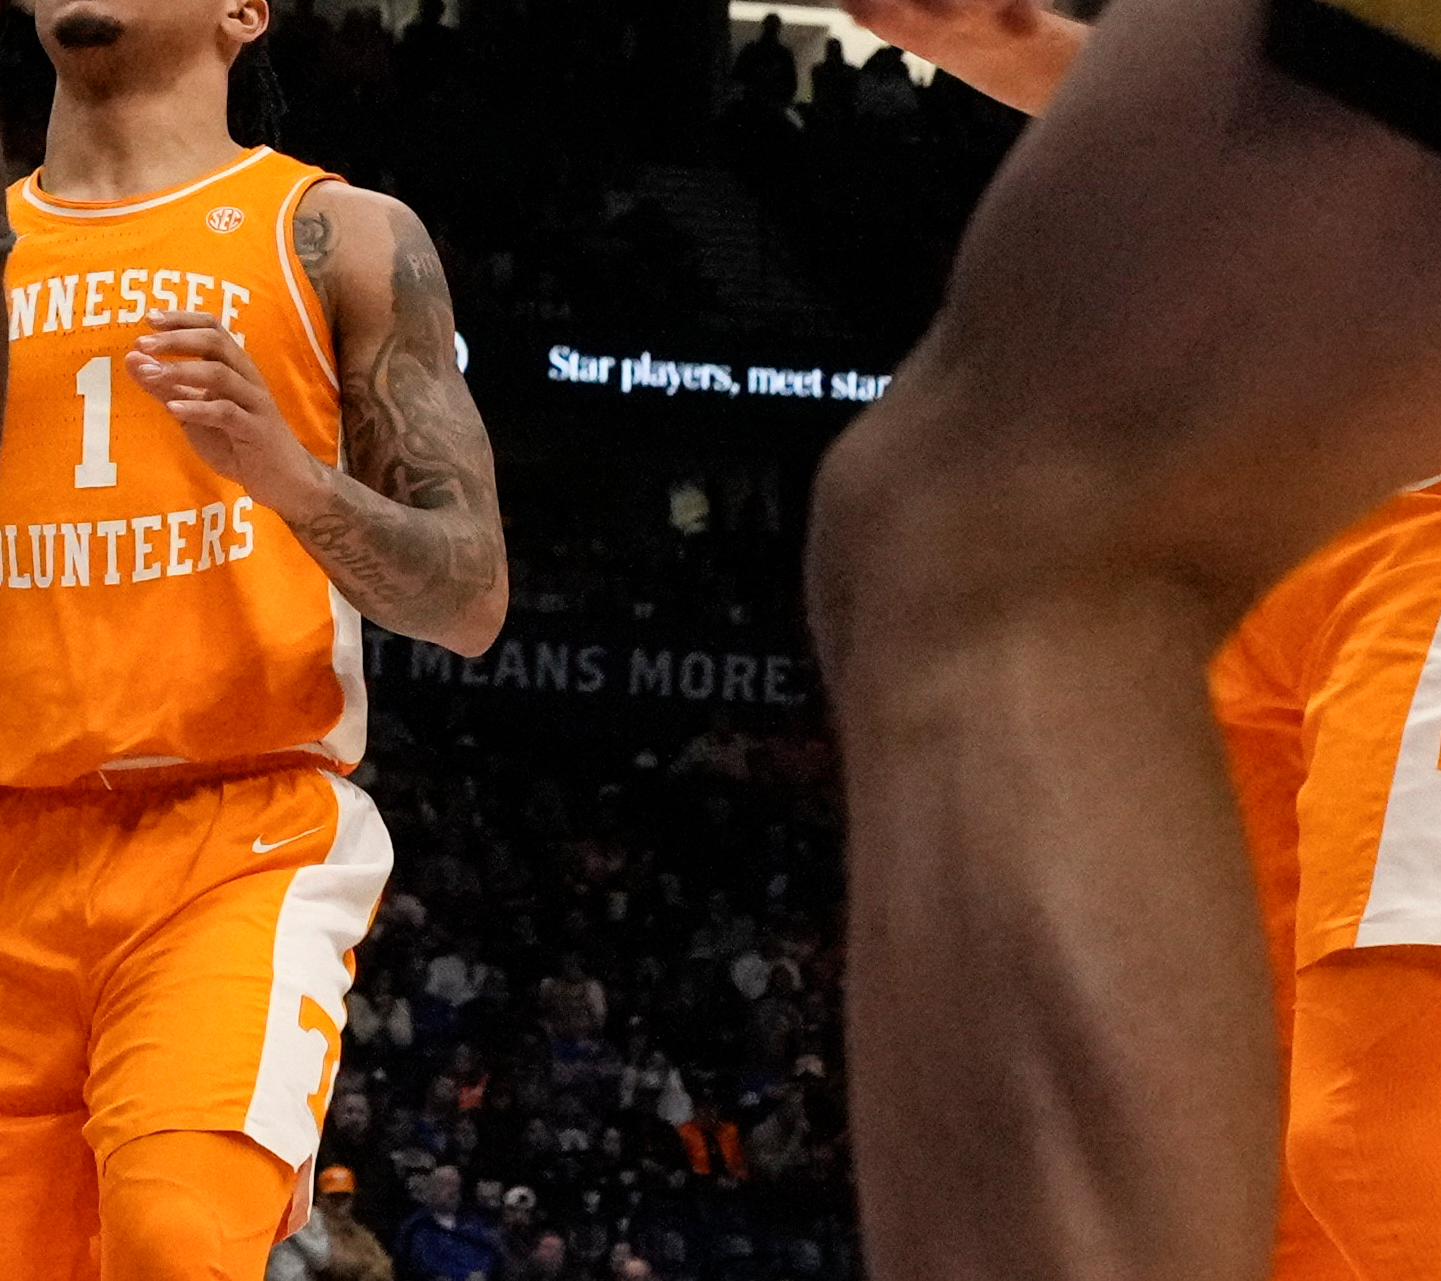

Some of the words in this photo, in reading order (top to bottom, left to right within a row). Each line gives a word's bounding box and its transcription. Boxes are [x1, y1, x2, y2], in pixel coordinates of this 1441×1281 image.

[206, 207, 244, 234] SEC
[547, 344, 617, 385] Star
[620, 350, 741, 399] players,
[747, 366, 824, 399] meet
[73, 355, 118, 489] 1
